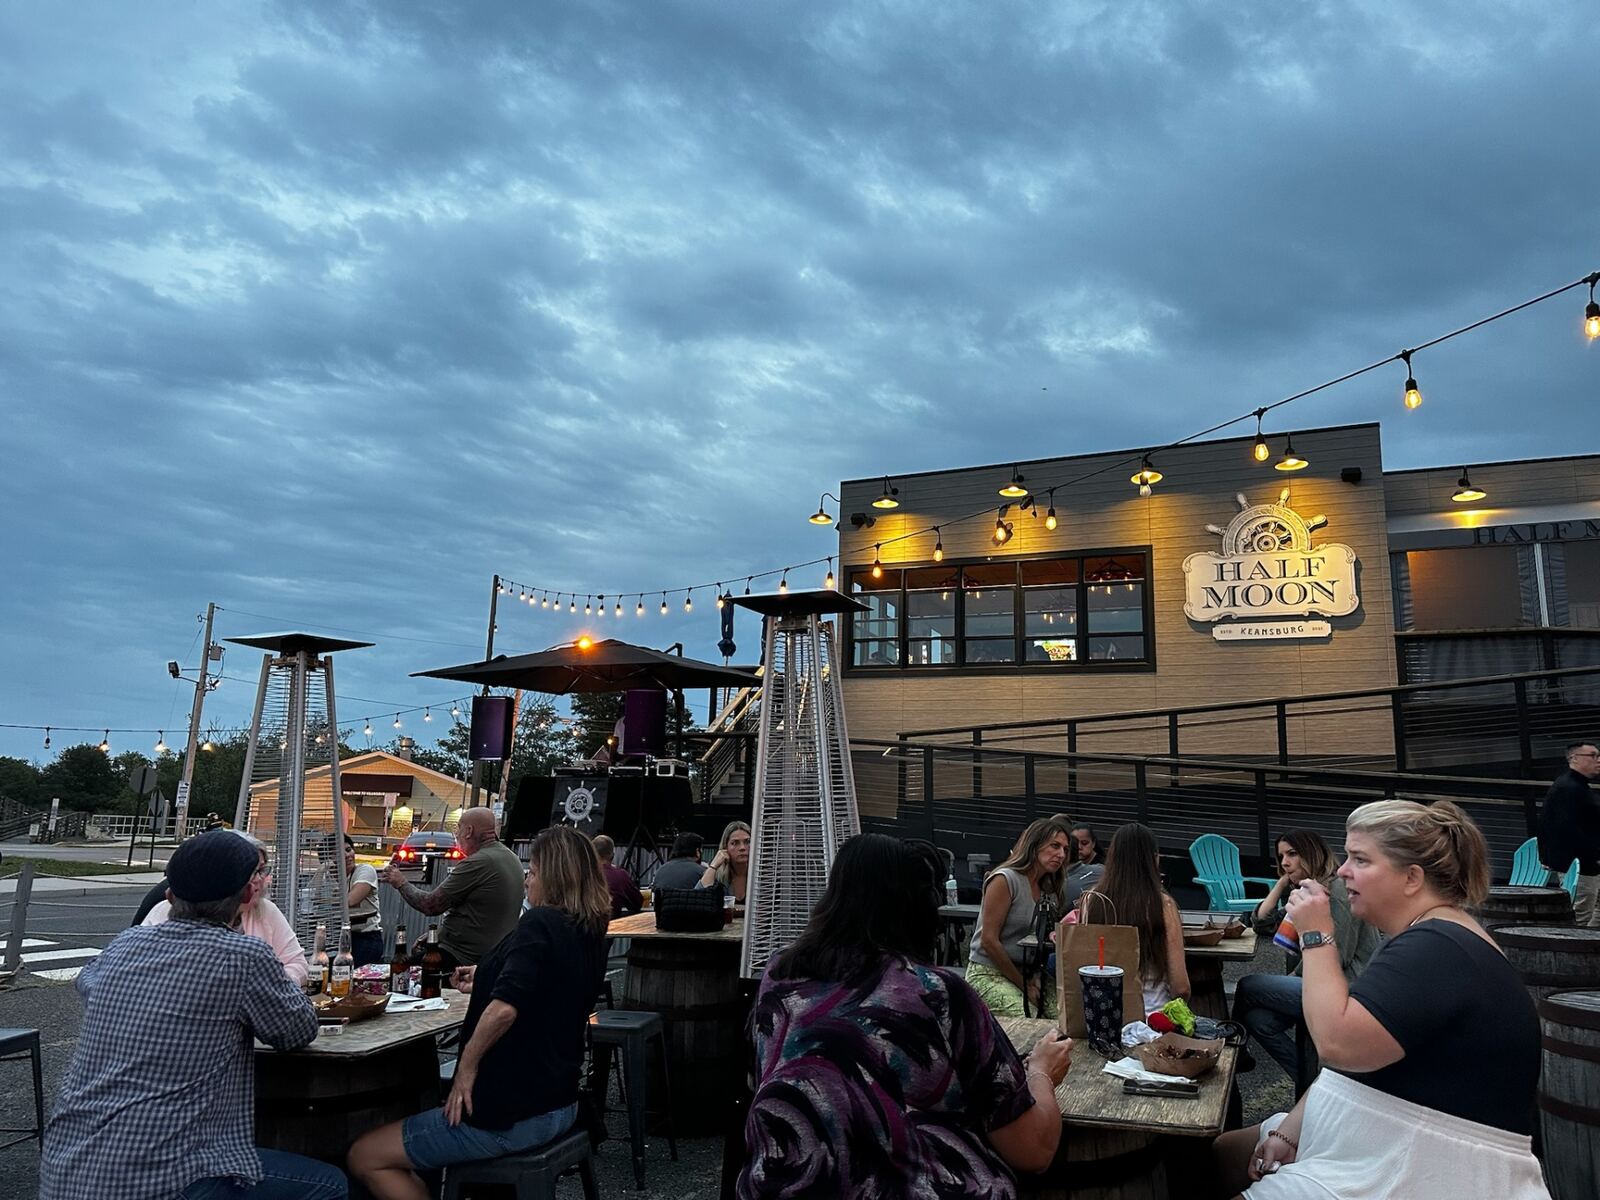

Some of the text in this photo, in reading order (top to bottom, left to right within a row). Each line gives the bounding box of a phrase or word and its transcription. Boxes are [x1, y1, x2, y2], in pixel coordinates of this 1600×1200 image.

[1472, 521, 1573, 545] HALF
[1213, 556, 1326, 582] HALF
[1201, 579, 1340, 609] MOON
[1240, 625, 1304, 636] KEANSBURG
